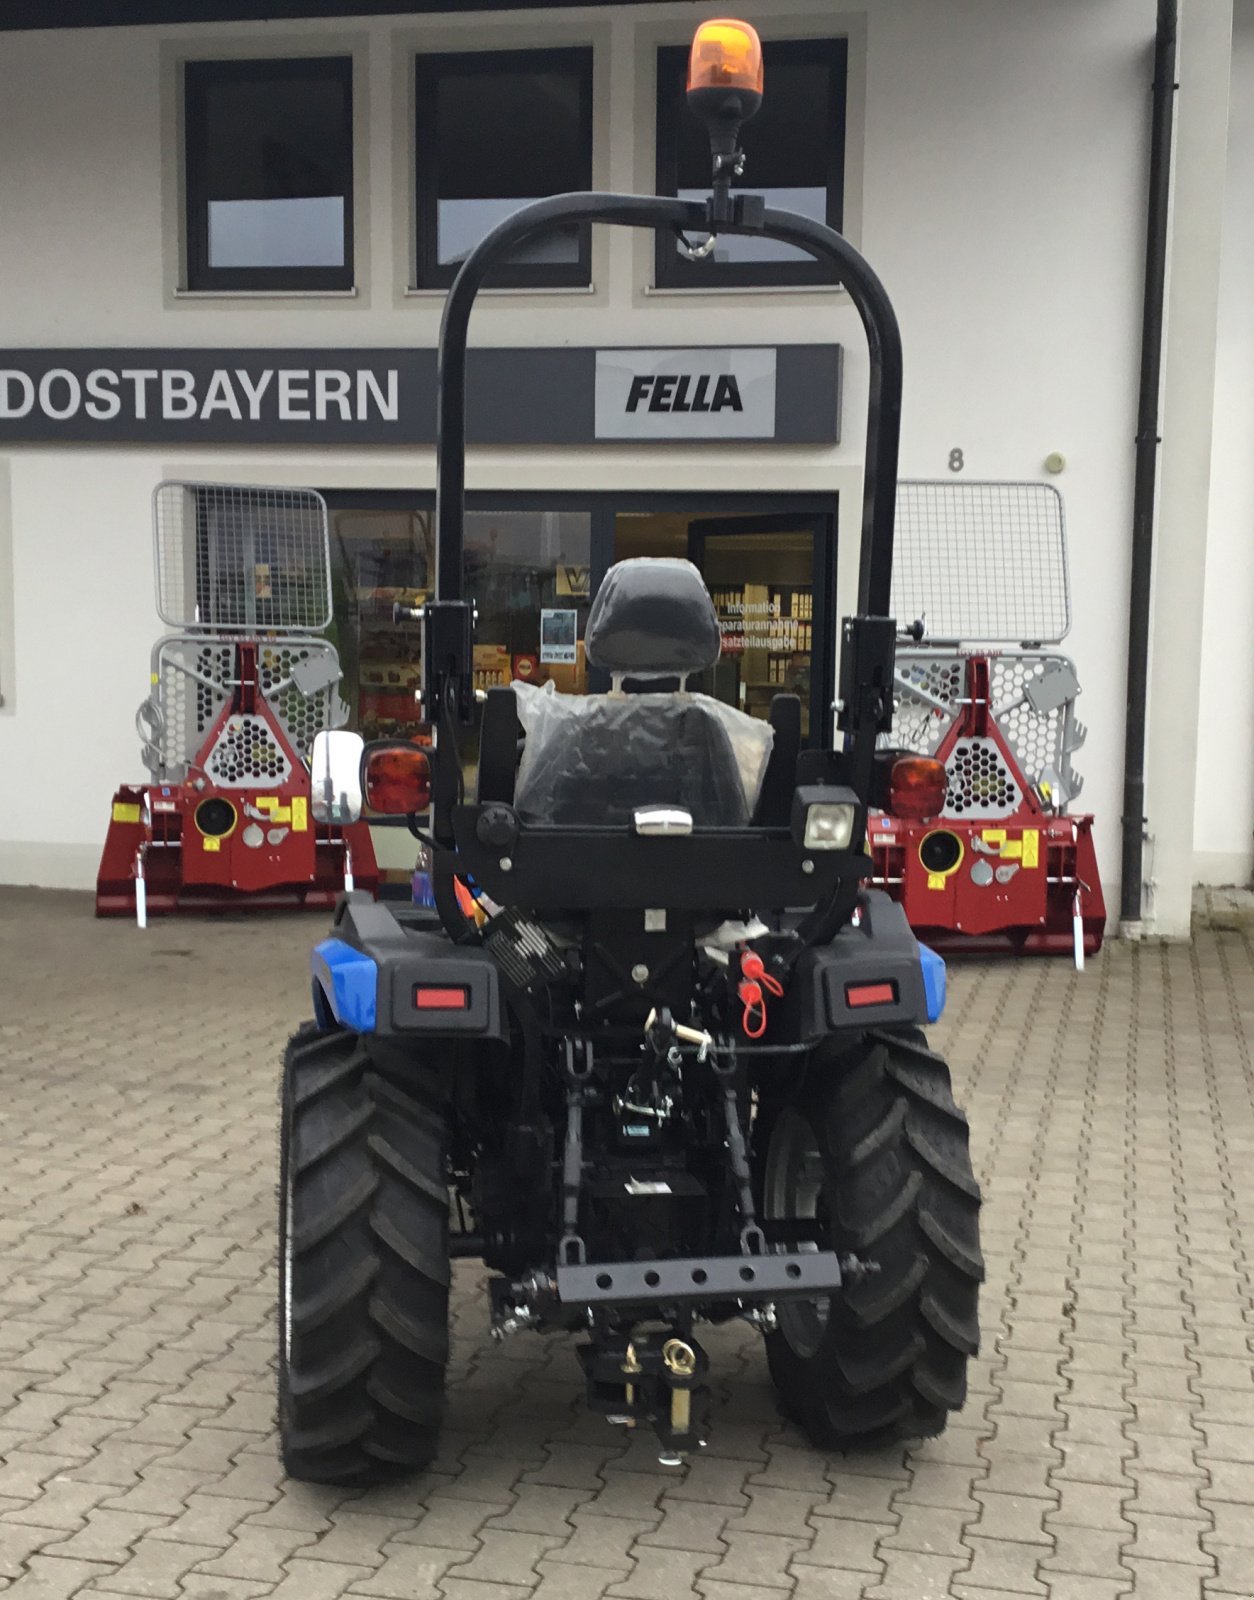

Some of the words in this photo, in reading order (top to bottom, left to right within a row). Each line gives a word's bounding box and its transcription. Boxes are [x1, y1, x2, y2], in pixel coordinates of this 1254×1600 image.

[0, 368, 399, 421] DOSTBAYERN
[625, 374, 743, 412] FELLA
[949, 447, 964, 472] 8
[727, 601, 781, 614] Information
